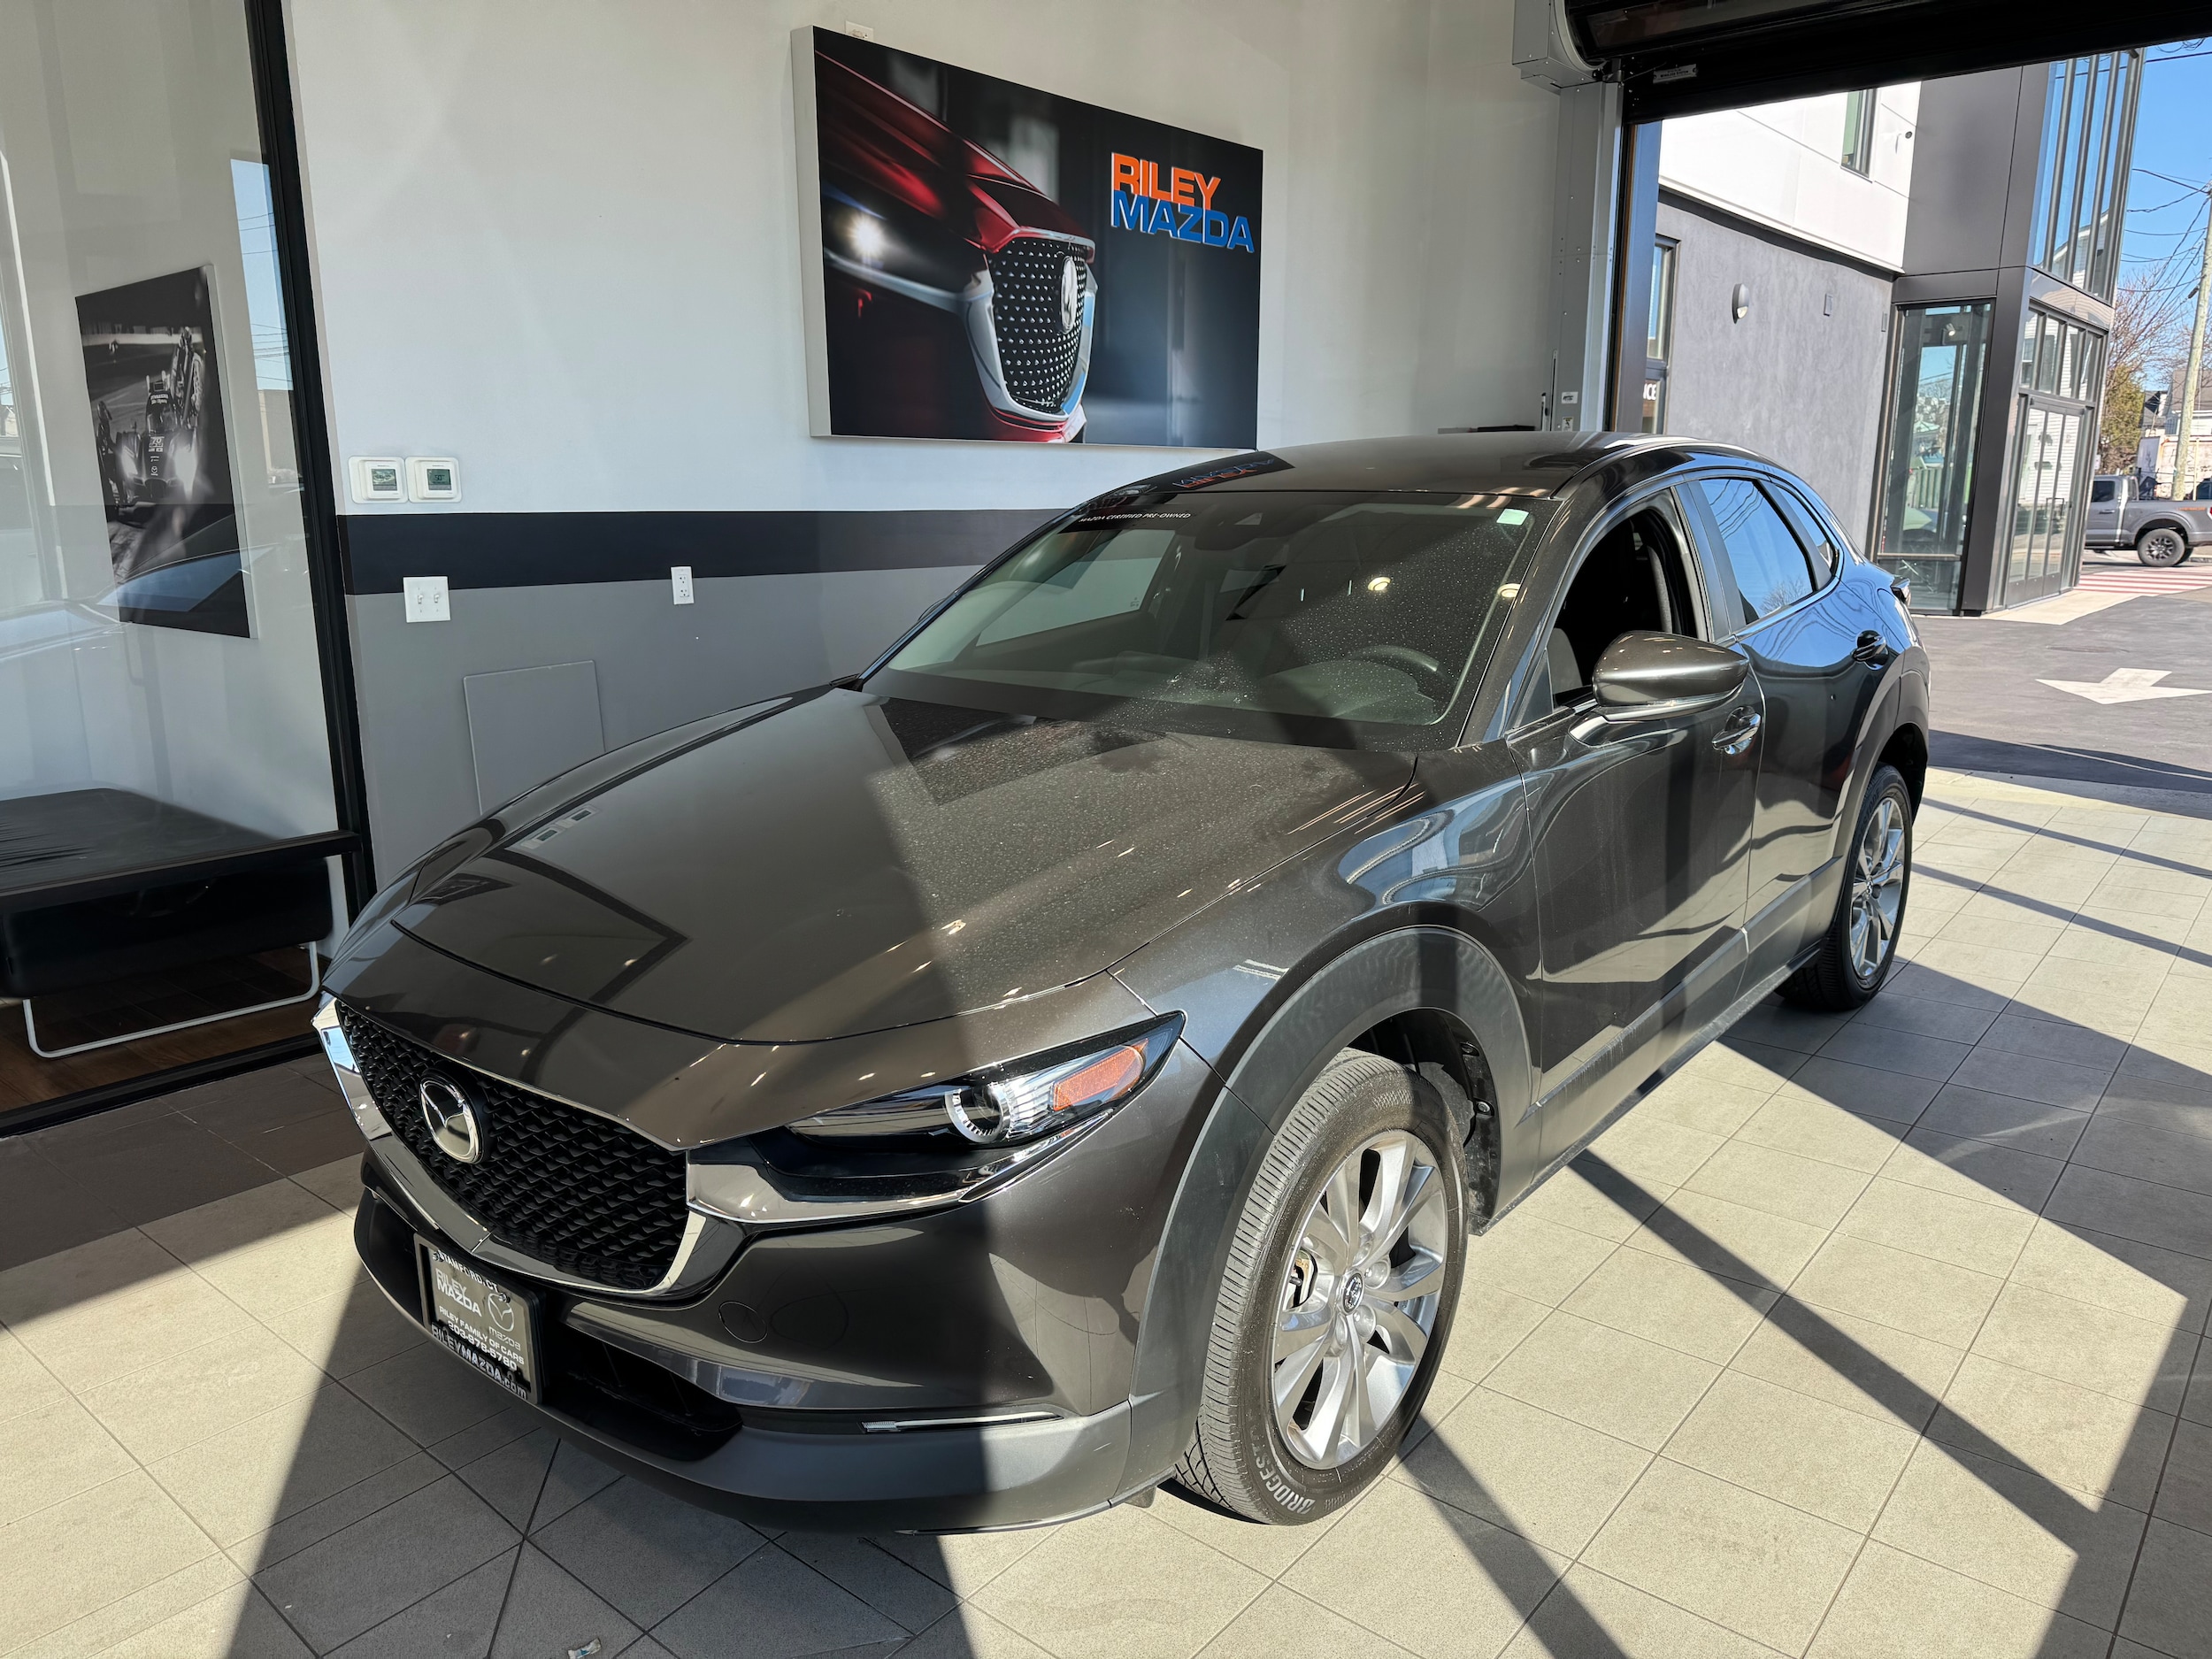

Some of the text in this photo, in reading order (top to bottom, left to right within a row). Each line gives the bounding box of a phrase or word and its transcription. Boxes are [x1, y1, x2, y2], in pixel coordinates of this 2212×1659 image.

[1111, 151, 1221, 211] RILEY
[1110, 189, 1255, 254] MAZDA
[435, 1267, 467, 1295] RILEY
[437, 1277, 482, 1317] MAZDA
[439, 1306, 524, 1365] RILEY FAMILY OF CARS
